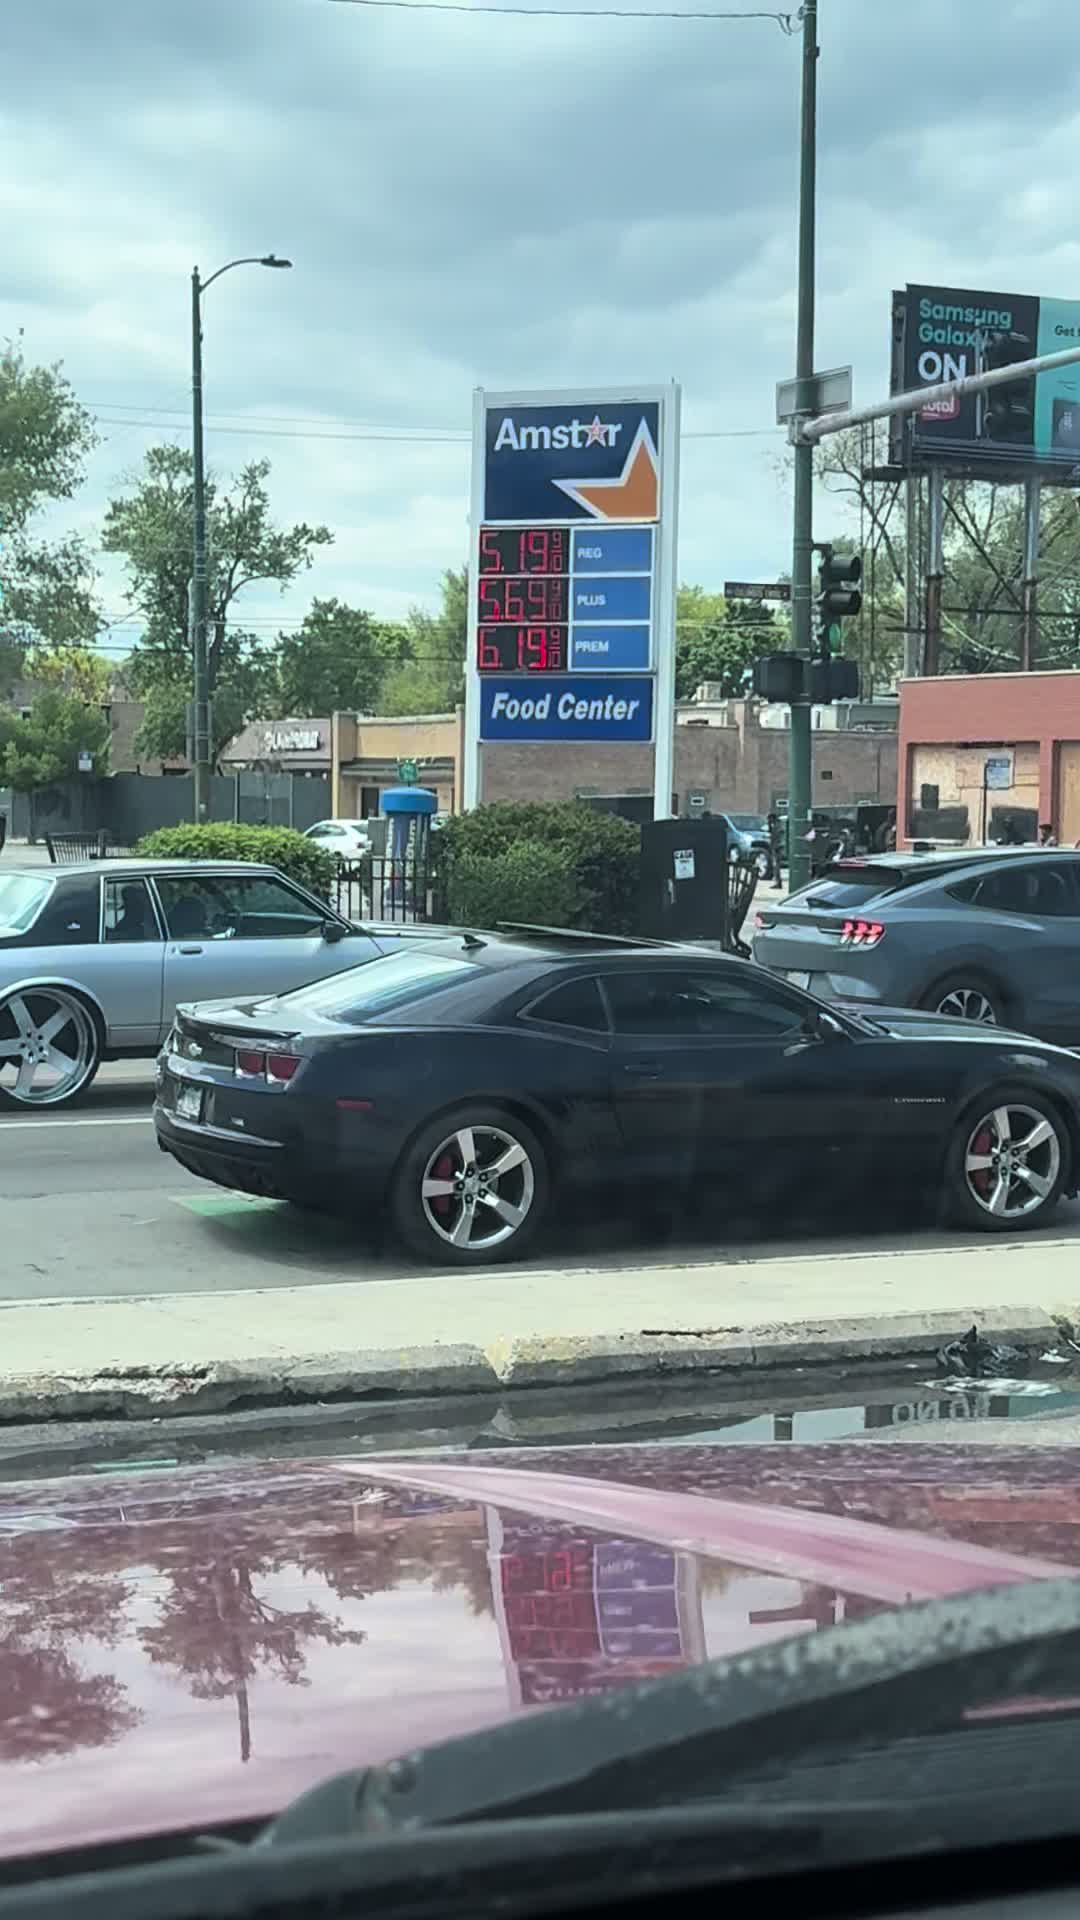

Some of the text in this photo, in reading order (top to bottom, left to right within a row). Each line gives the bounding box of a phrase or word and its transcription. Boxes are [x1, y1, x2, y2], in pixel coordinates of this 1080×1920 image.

[919, 298, 1012, 329] Samsung
[918, 350, 966, 382] ON
[577, 547, 602, 559] REG
[577, 594, 606, 606] PLUS
[575, 640, 609, 653] PREM
[491, 692, 640, 720] Food Center
